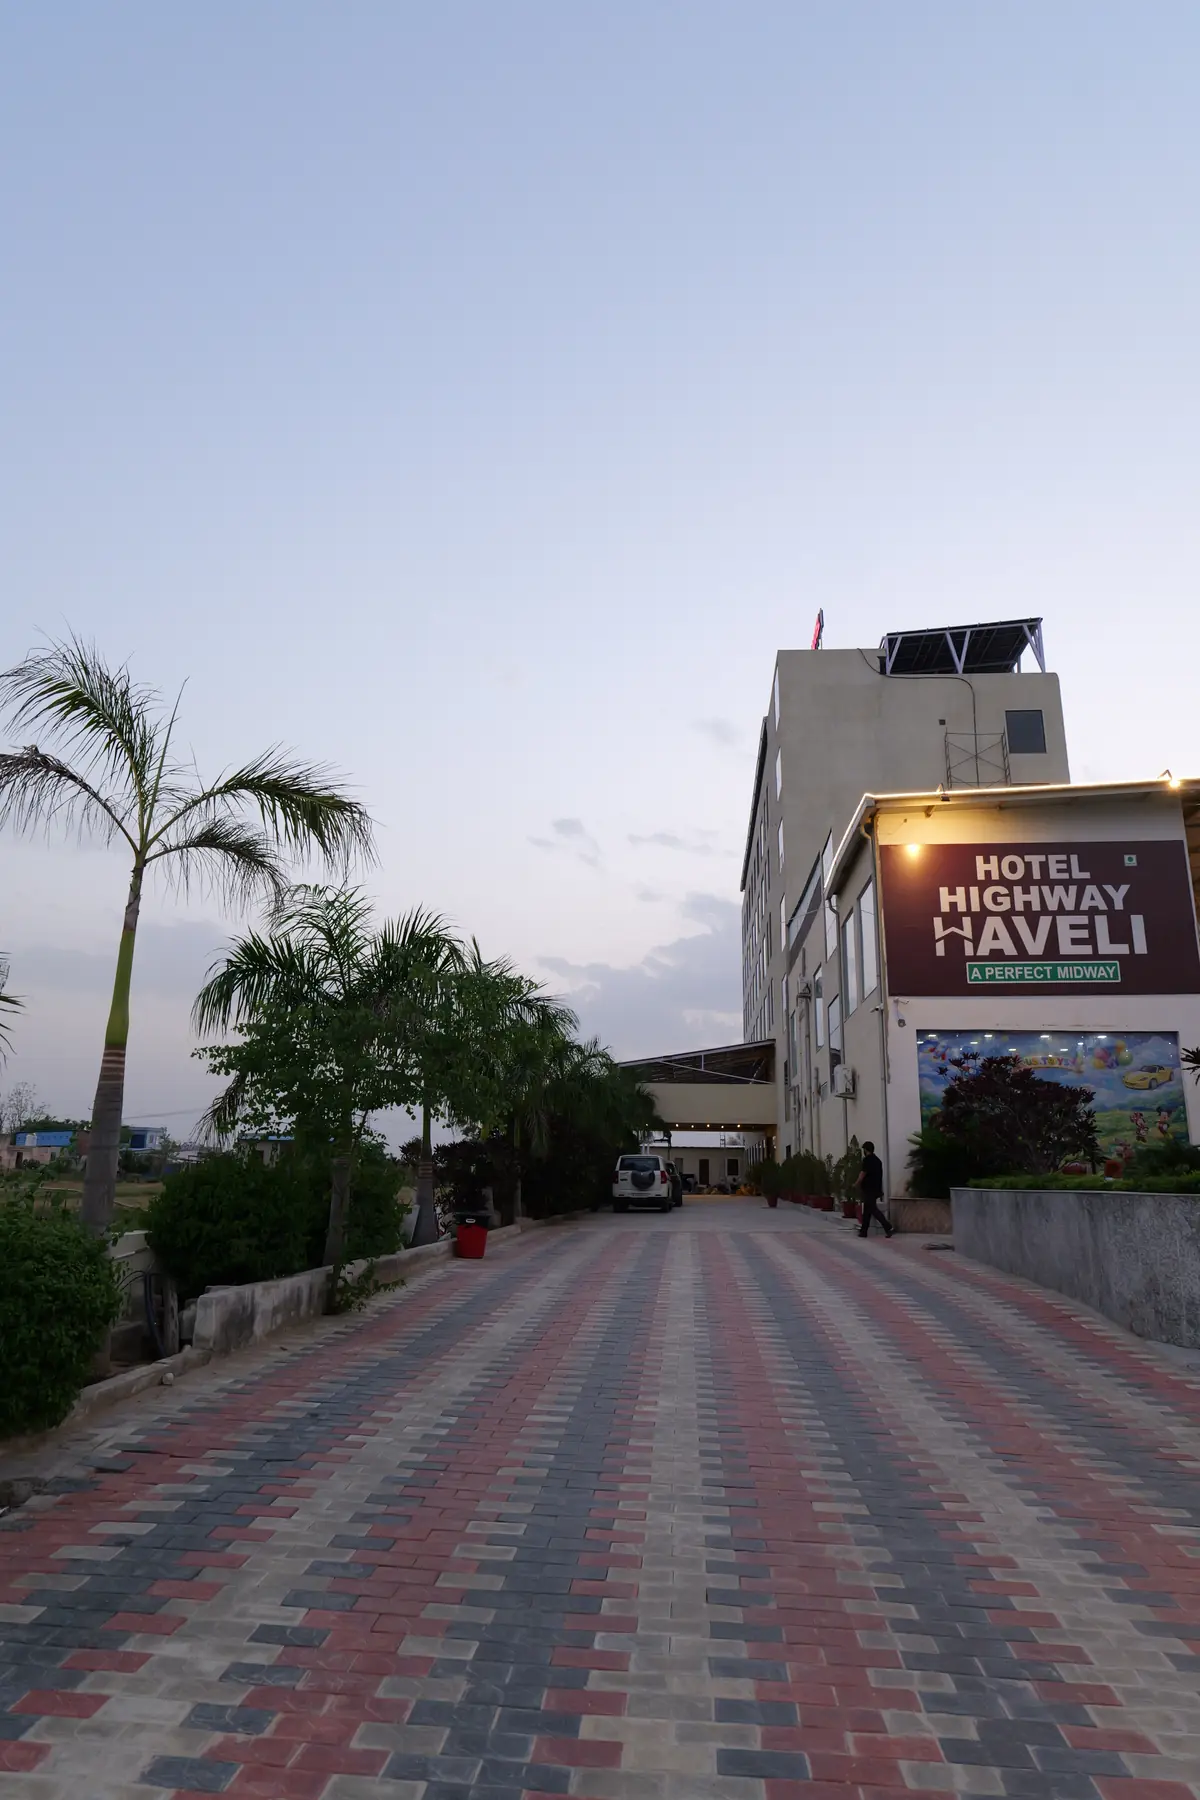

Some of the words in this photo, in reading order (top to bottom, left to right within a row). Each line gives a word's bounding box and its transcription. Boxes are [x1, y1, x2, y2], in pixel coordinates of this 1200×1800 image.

[975, 854, 1091, 881] HOTEL
[938, 884, 1131, 913] HIGHWAY
[932, 914, 1148, 957] HAVELI
[971, 967, 982, 980] A
[985, 966, 1053, 980] PERFECT
[1057, 966, 1116, 979] MIDWAY
